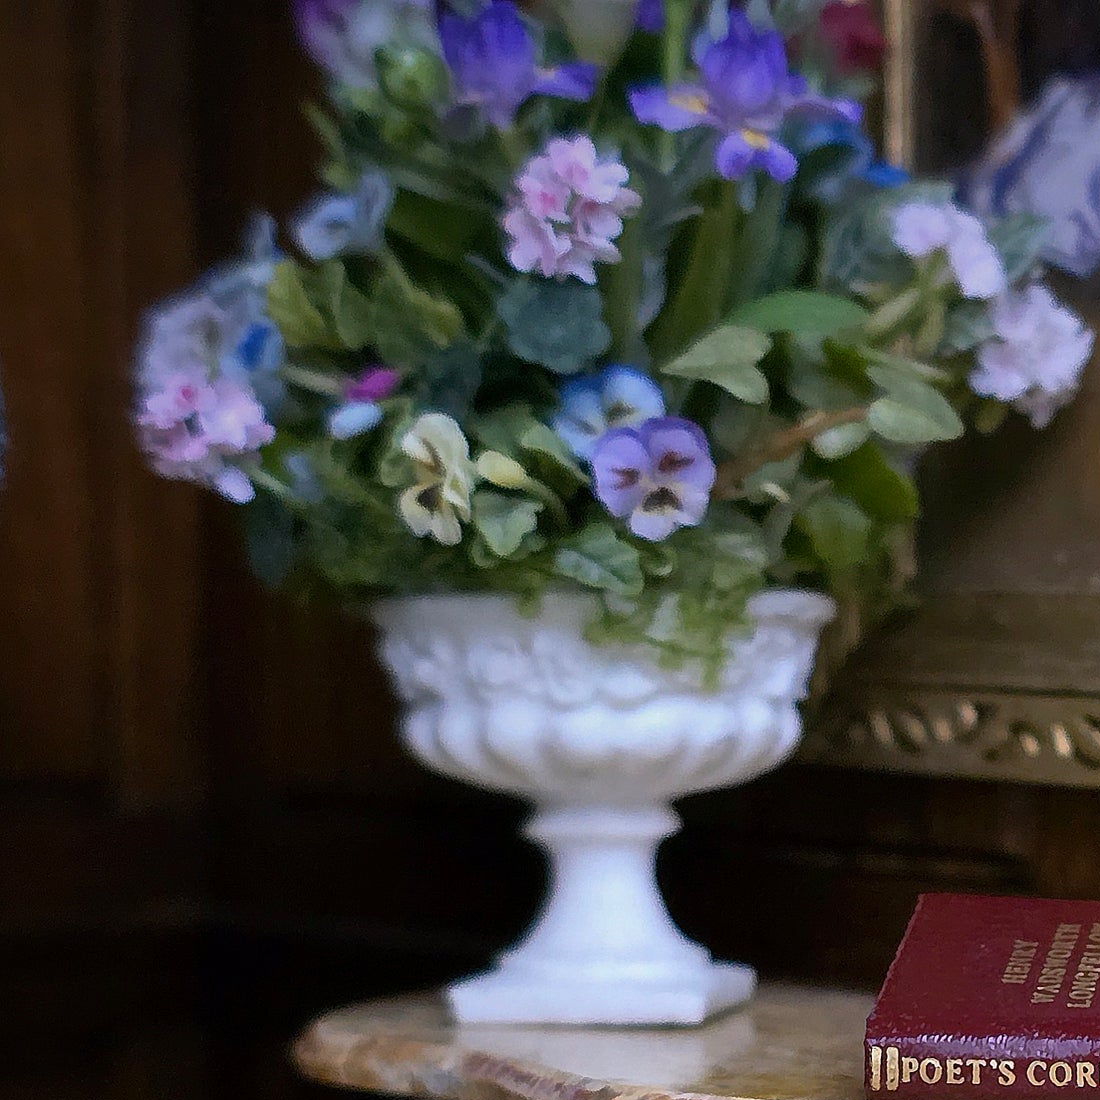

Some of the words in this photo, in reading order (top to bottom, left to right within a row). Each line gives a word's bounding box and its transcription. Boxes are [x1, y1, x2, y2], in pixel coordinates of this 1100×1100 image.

[1001, 939, 1039, 984] HENRY
[1031, 923, 1081, 1004] WADSWORTH
[902, 1056, 1015, 1085] POET'S
